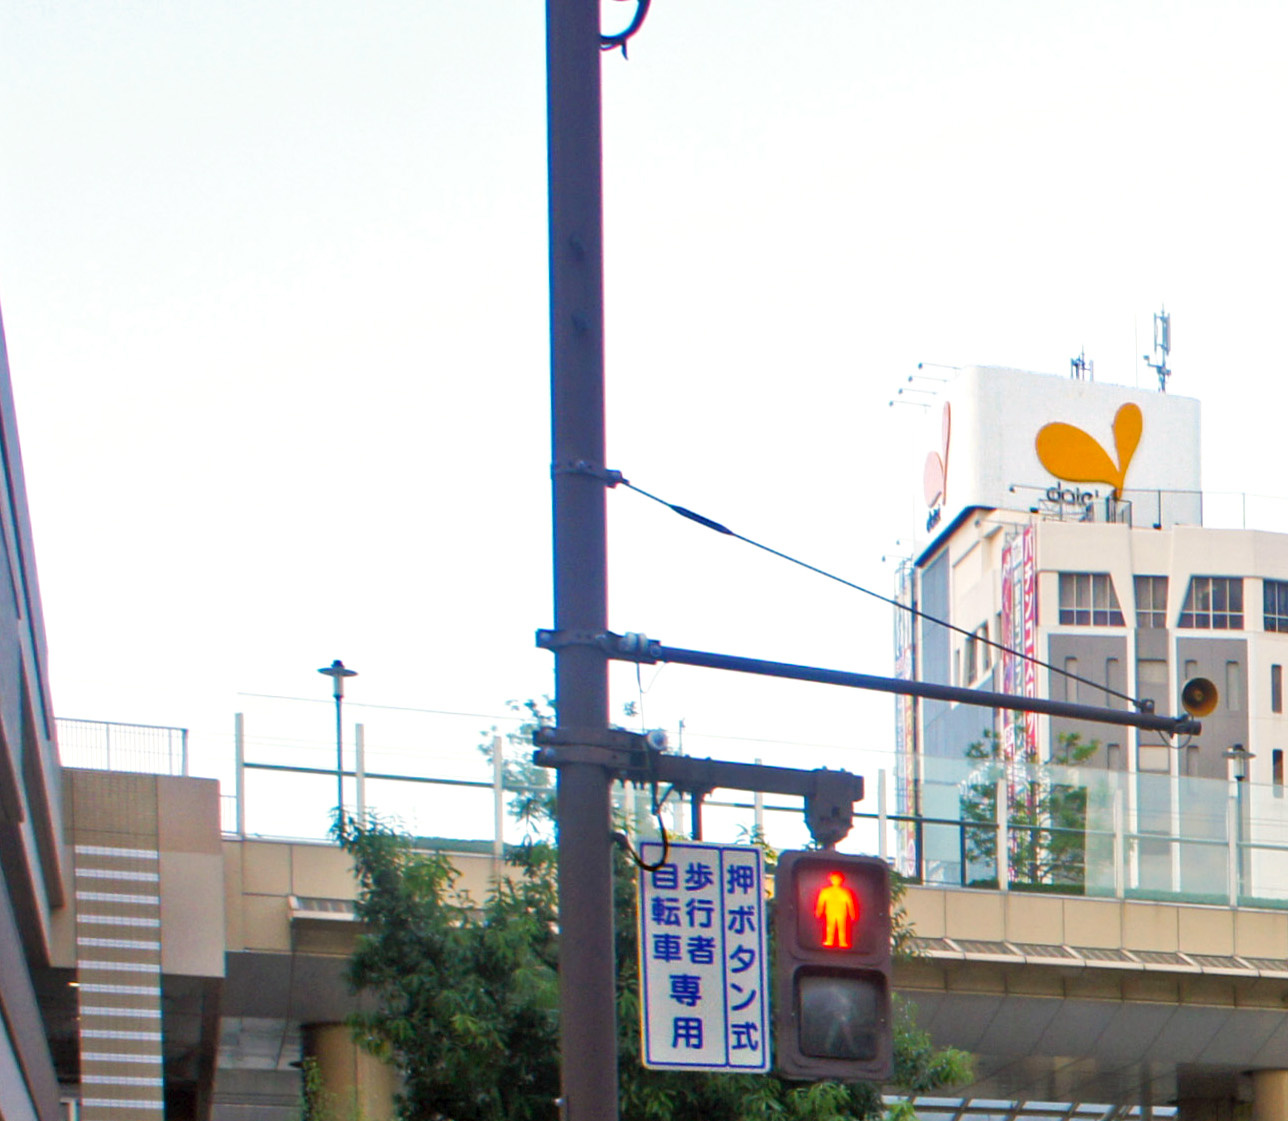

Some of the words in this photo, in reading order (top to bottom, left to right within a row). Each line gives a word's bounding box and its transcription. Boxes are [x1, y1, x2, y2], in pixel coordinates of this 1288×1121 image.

[650, 863, 683, 963] 自転車
[684, 862, 716, 967] 歩行者
[726, 863, 759, 1053] 押ボタン式
[669, 973, 704, 1051] 専用
